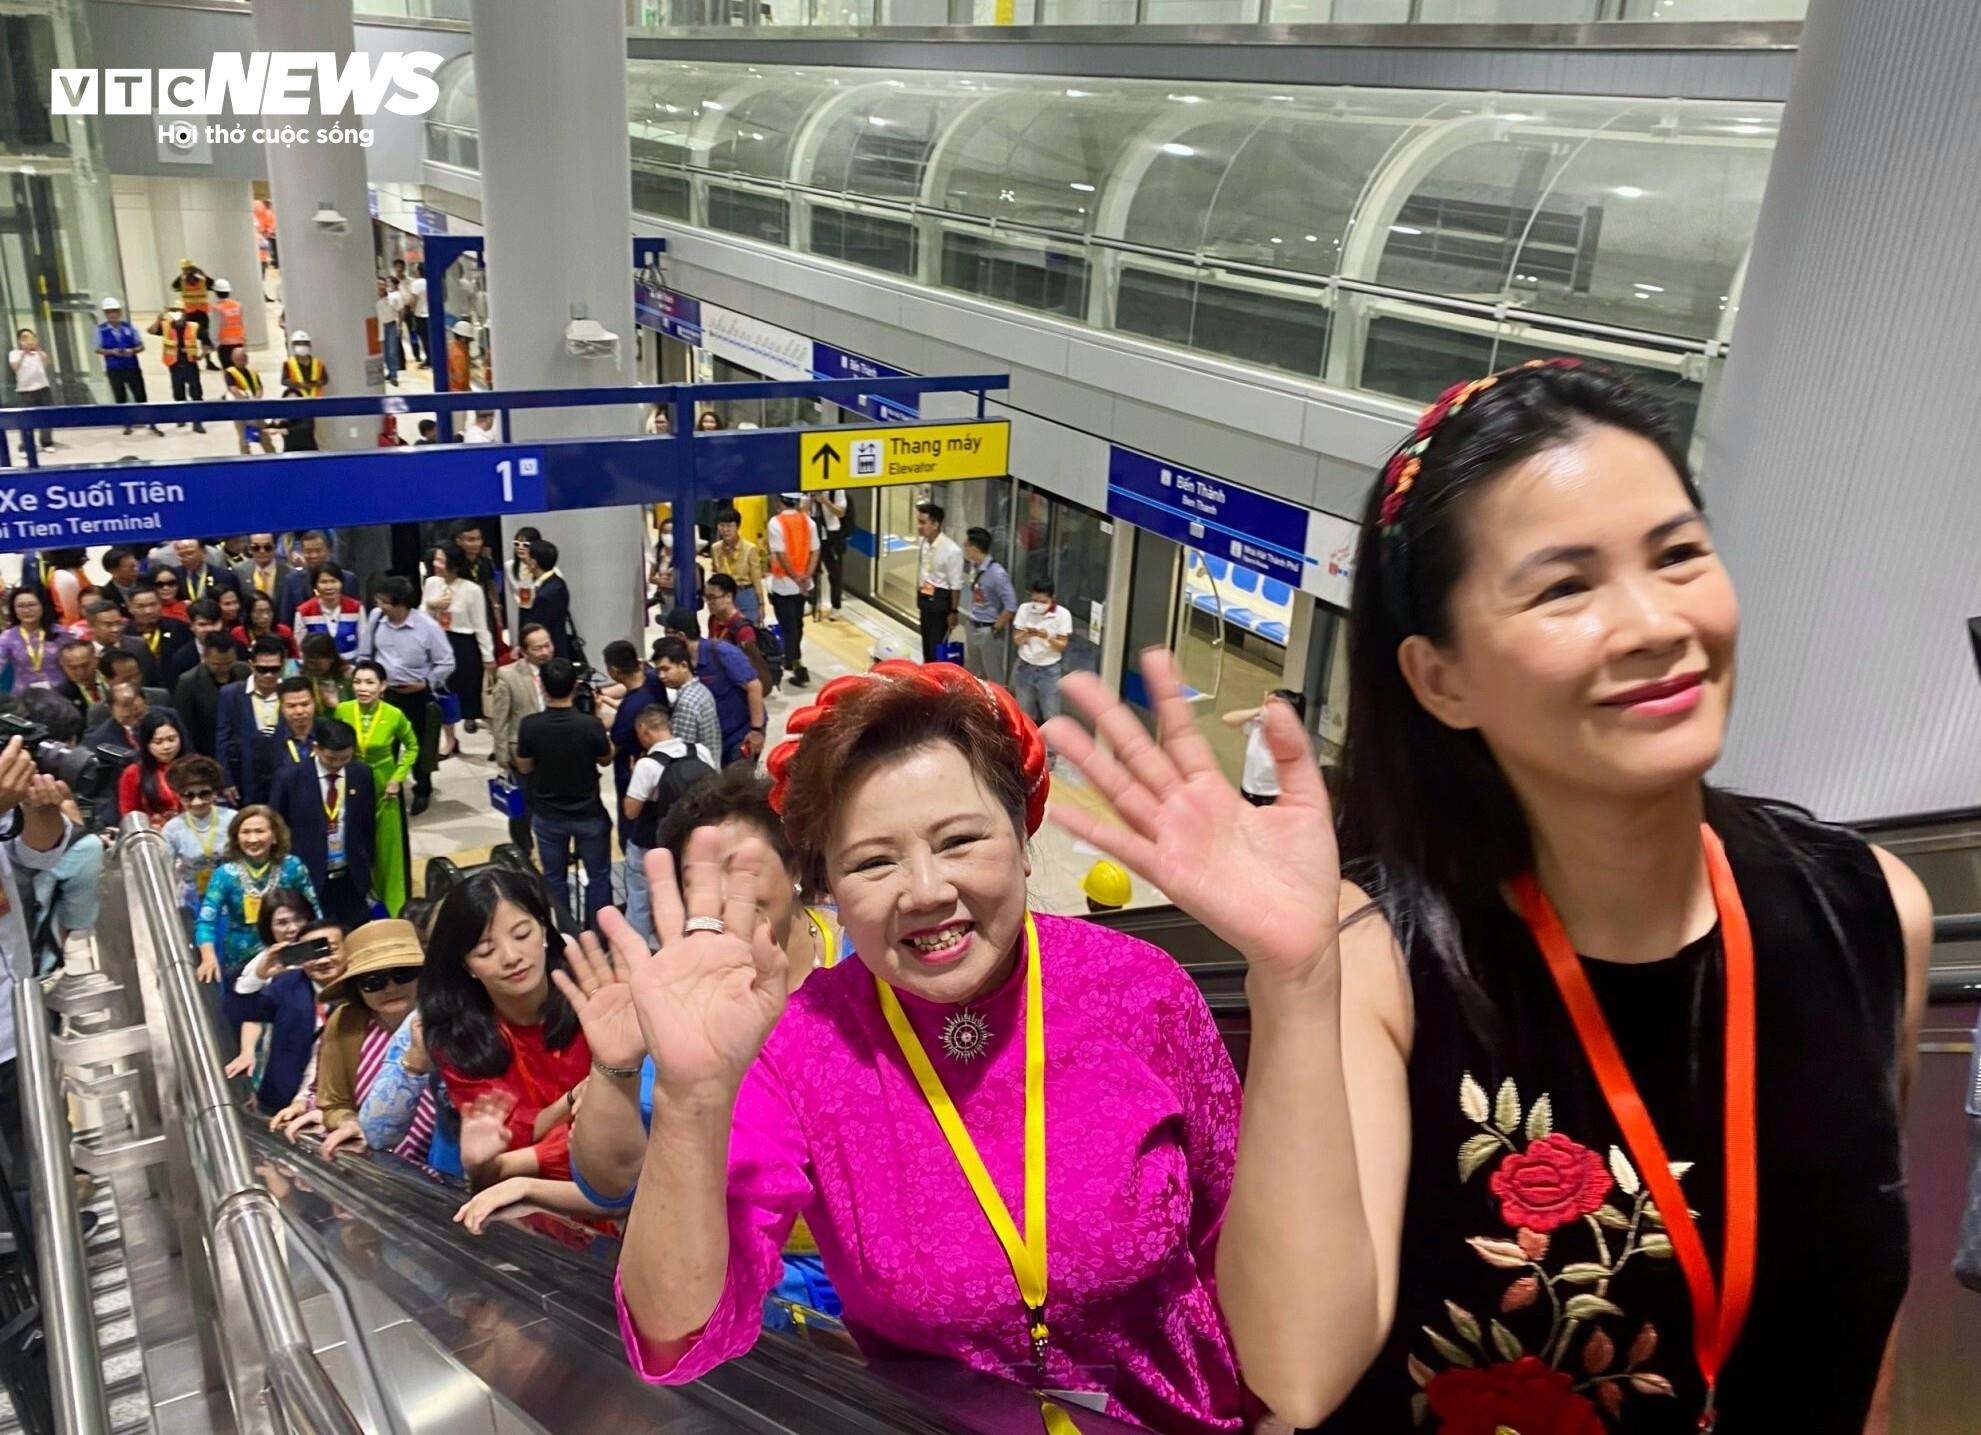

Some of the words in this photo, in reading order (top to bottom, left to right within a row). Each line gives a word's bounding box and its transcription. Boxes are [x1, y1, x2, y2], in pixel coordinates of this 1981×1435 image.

[890, 437, 942, 457] Thang
[947, 432, 982, 454] máy
[888, 460, 937, 475] Elevator
[496, 460, 513, 502] 1
[46, 480, 114, 510] Suối
[119, 481, 184, 505] Tiên
[12, 520, 63, 538] Tien
[65, 512, 162, 535] Terminal
